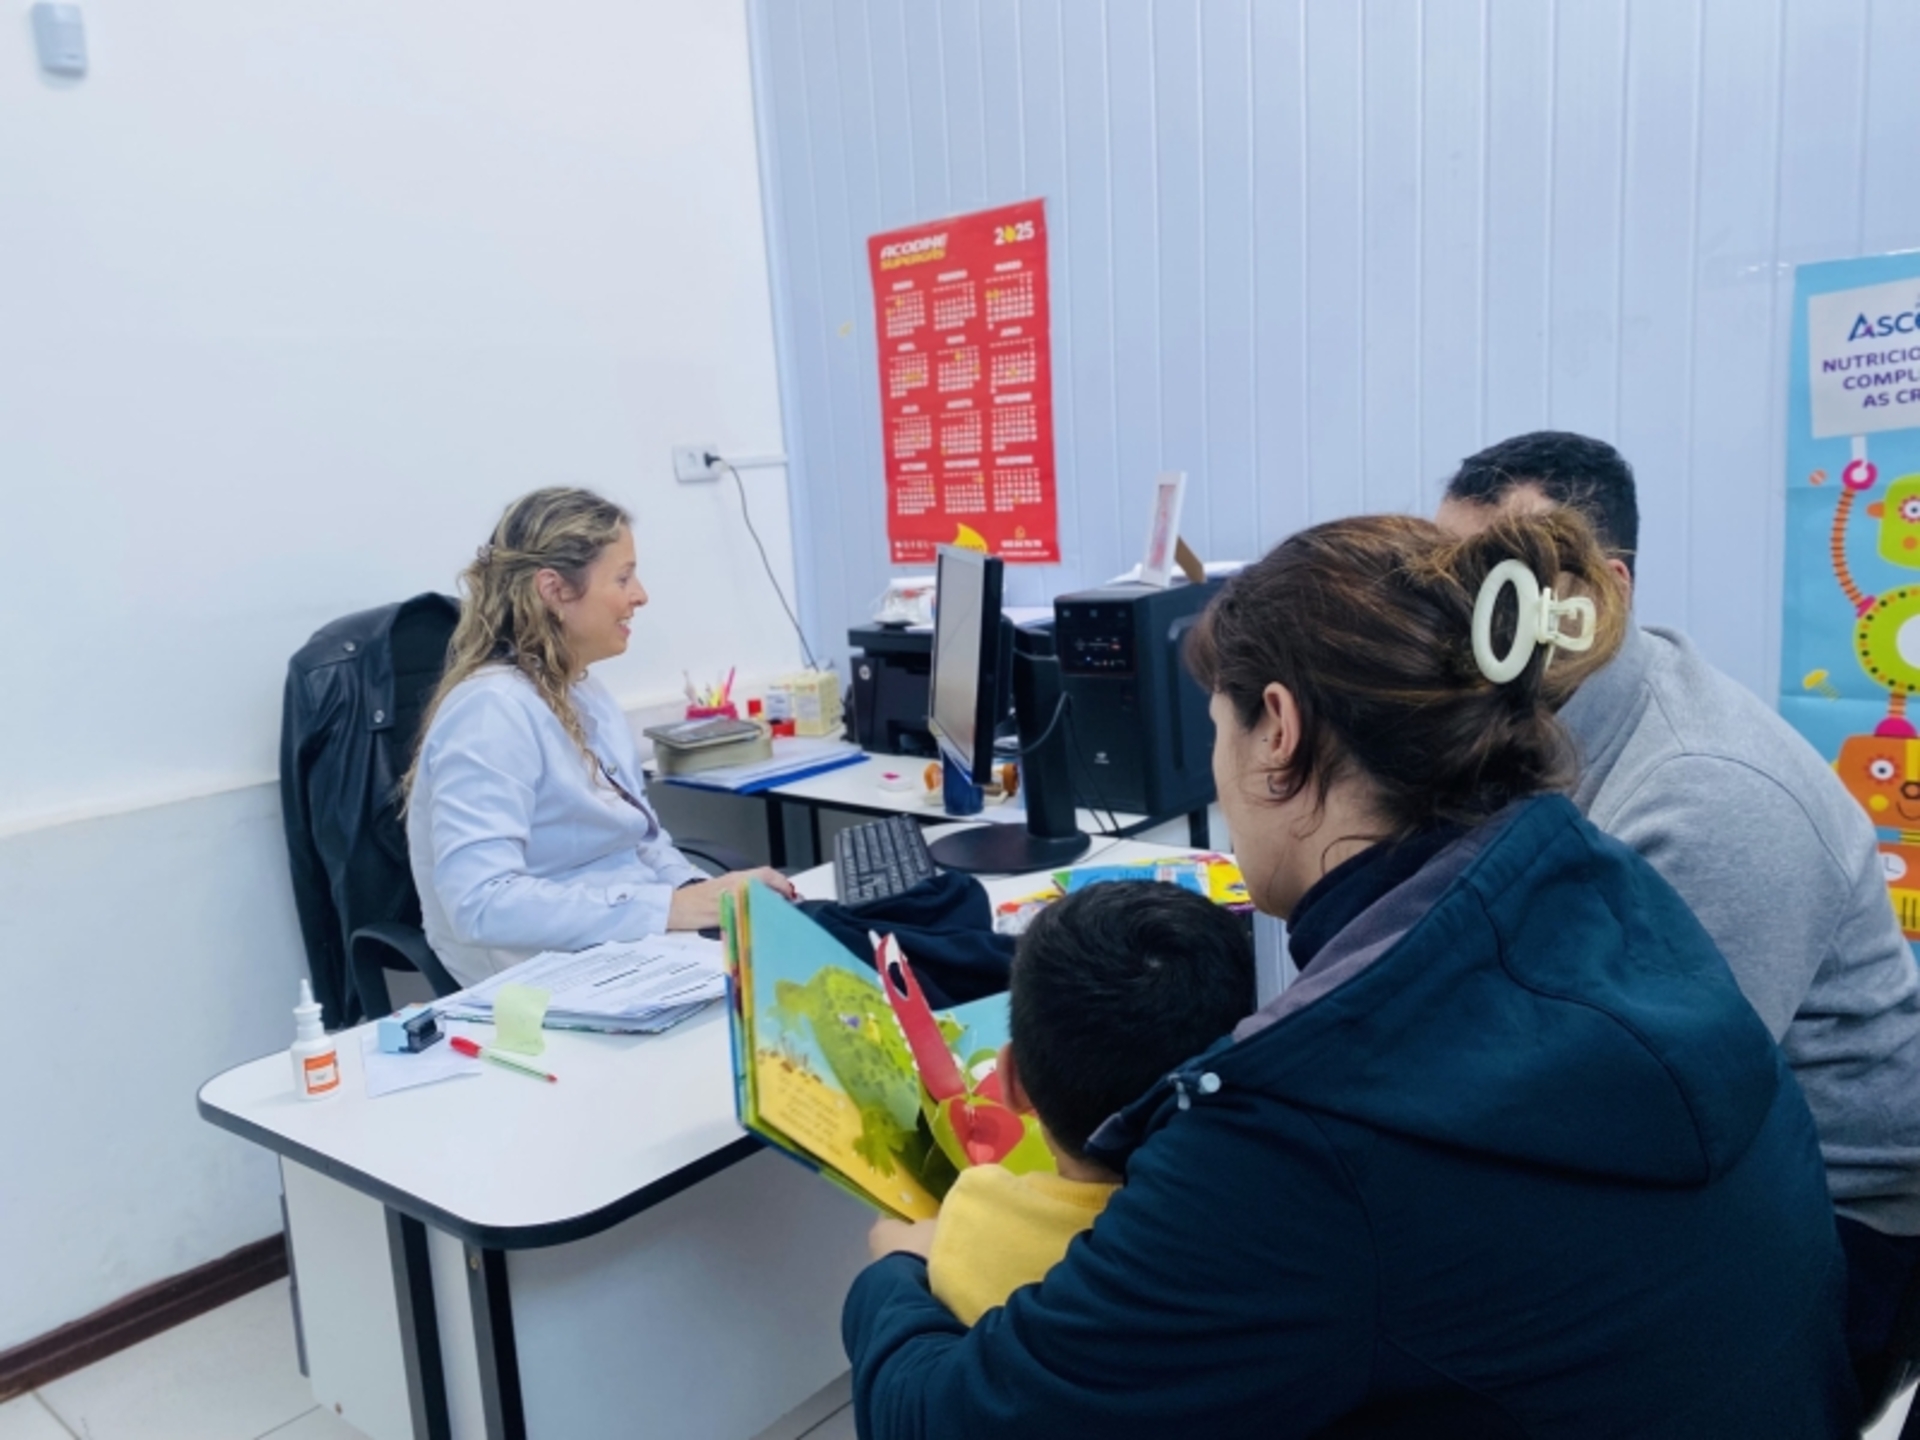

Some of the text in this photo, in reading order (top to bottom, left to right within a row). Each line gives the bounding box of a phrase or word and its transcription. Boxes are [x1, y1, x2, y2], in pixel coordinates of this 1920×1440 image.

[1848, 311, 1920, 342] ASC
[1822, 346, 1920, 374] NUTRICIO
[1842, 368, 1920, 391] COMPL
[1862, 391, 1890, 409] AS
